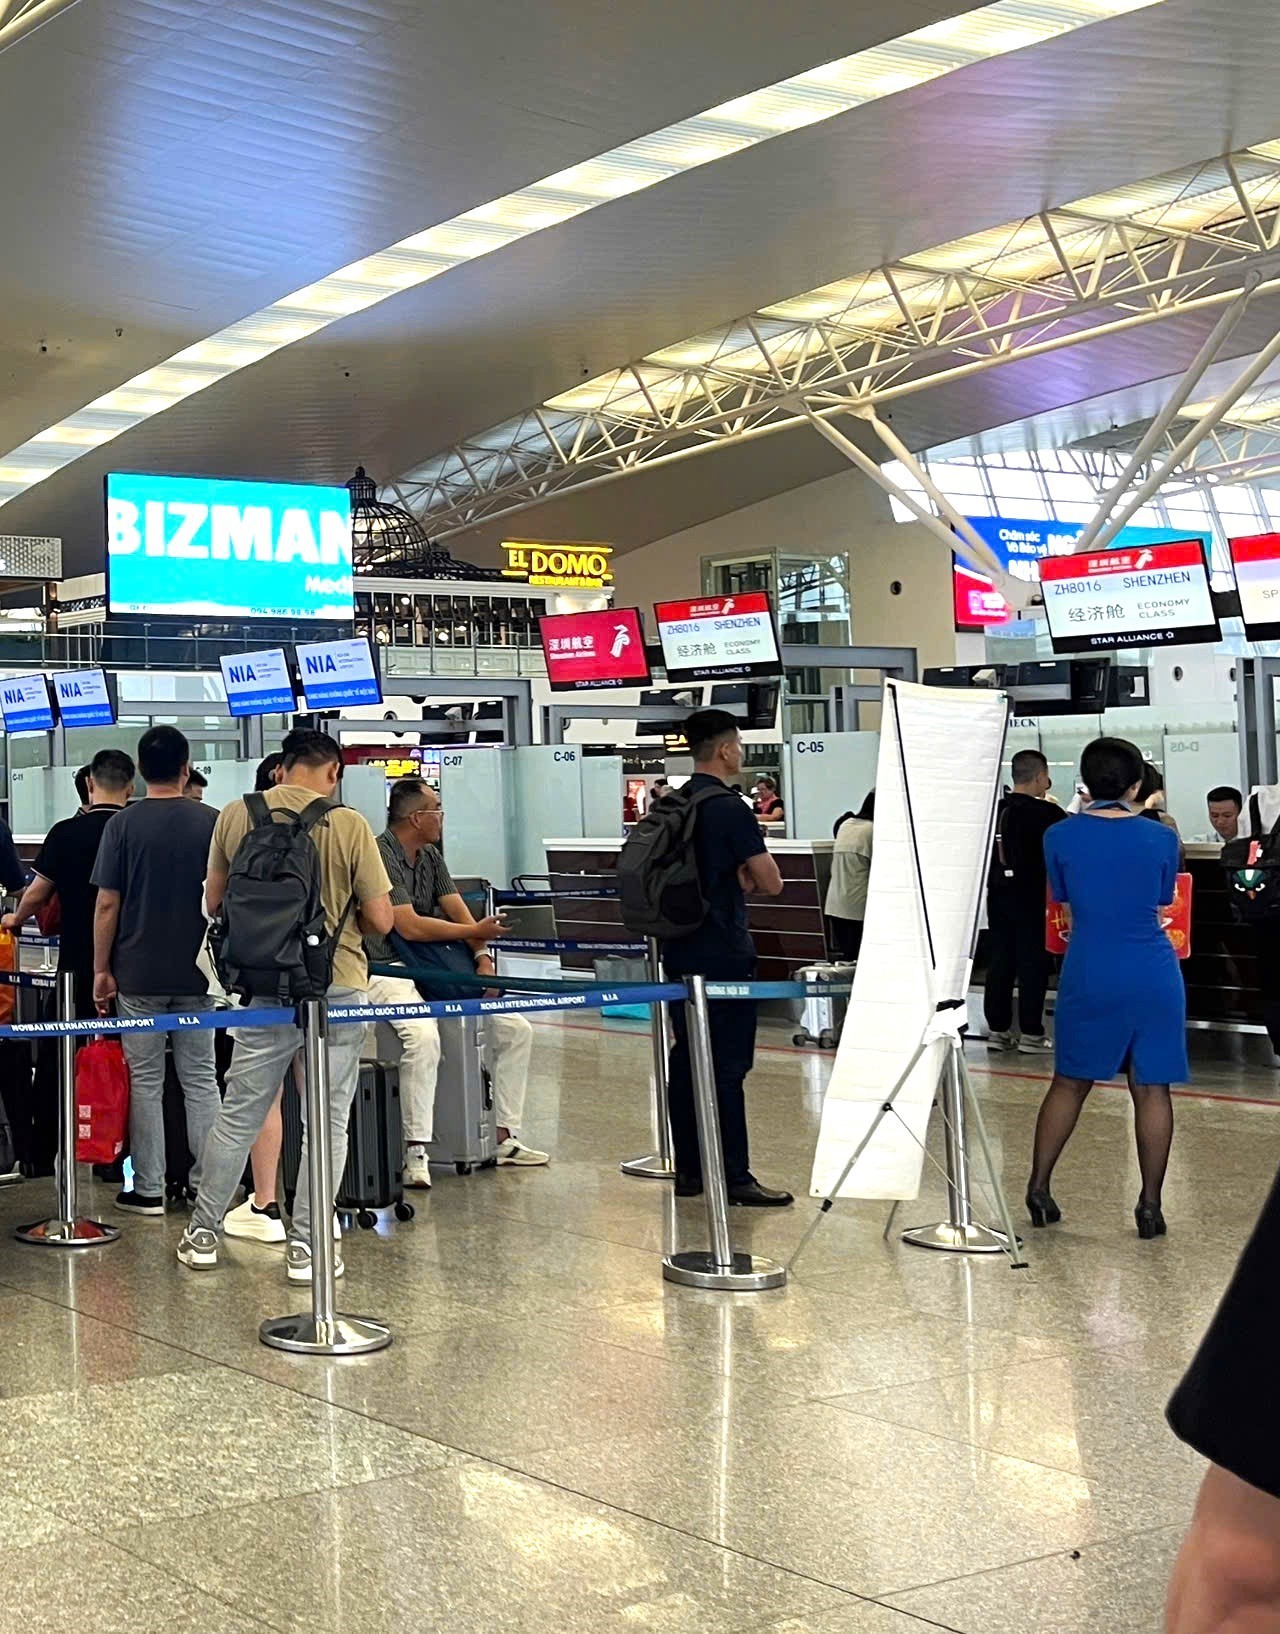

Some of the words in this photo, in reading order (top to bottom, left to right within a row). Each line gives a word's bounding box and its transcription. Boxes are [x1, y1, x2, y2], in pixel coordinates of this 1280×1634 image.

[108, 497, 353, 565] BIZMAN
[508, 549, 529, 568] EL
[531, 551, 607, 576] DOMO
[1054, 580, 1102, 596] ZH8016
[1123, 571, 1191, 589] SHENZHEN
[1137, 598, 1190, 610] ECONOMY
[1068, 603, 1126, 623] 经济舱
[1139, 609, 1176, 619] CLASS
[666, 624, 701, 635] ZH8016
[713, 616, 761, 631] SHENZHEN
[548, 635, 594, 651] 深圳航空
[1091, 635, 1115, 645] STAR
[1117, 632, 1164, 644] ALLIANCE
[306, 654, 337, 675] NIA
[711, 666, 743, 675] ALLIANCE
[228, 665, 257, 684] NIA
[4, 688, 25, 705] NIA
[60, 682, 83, 699] NIA
[797, 741, 825, 754] C-05
[443, 756, 463, 766] C-07
[553, 751, 576, 762] C-06
[505, 998, 556, 1008] INTERNATIONAL
[557, 996, 586, 1004] AIRPORT
[11, 1024, 44, 1032] NOIBAI
[45, 1020, 115, 1031] INTERNATIONAL
[116, 1018, 155, 1028] AIRPORT
